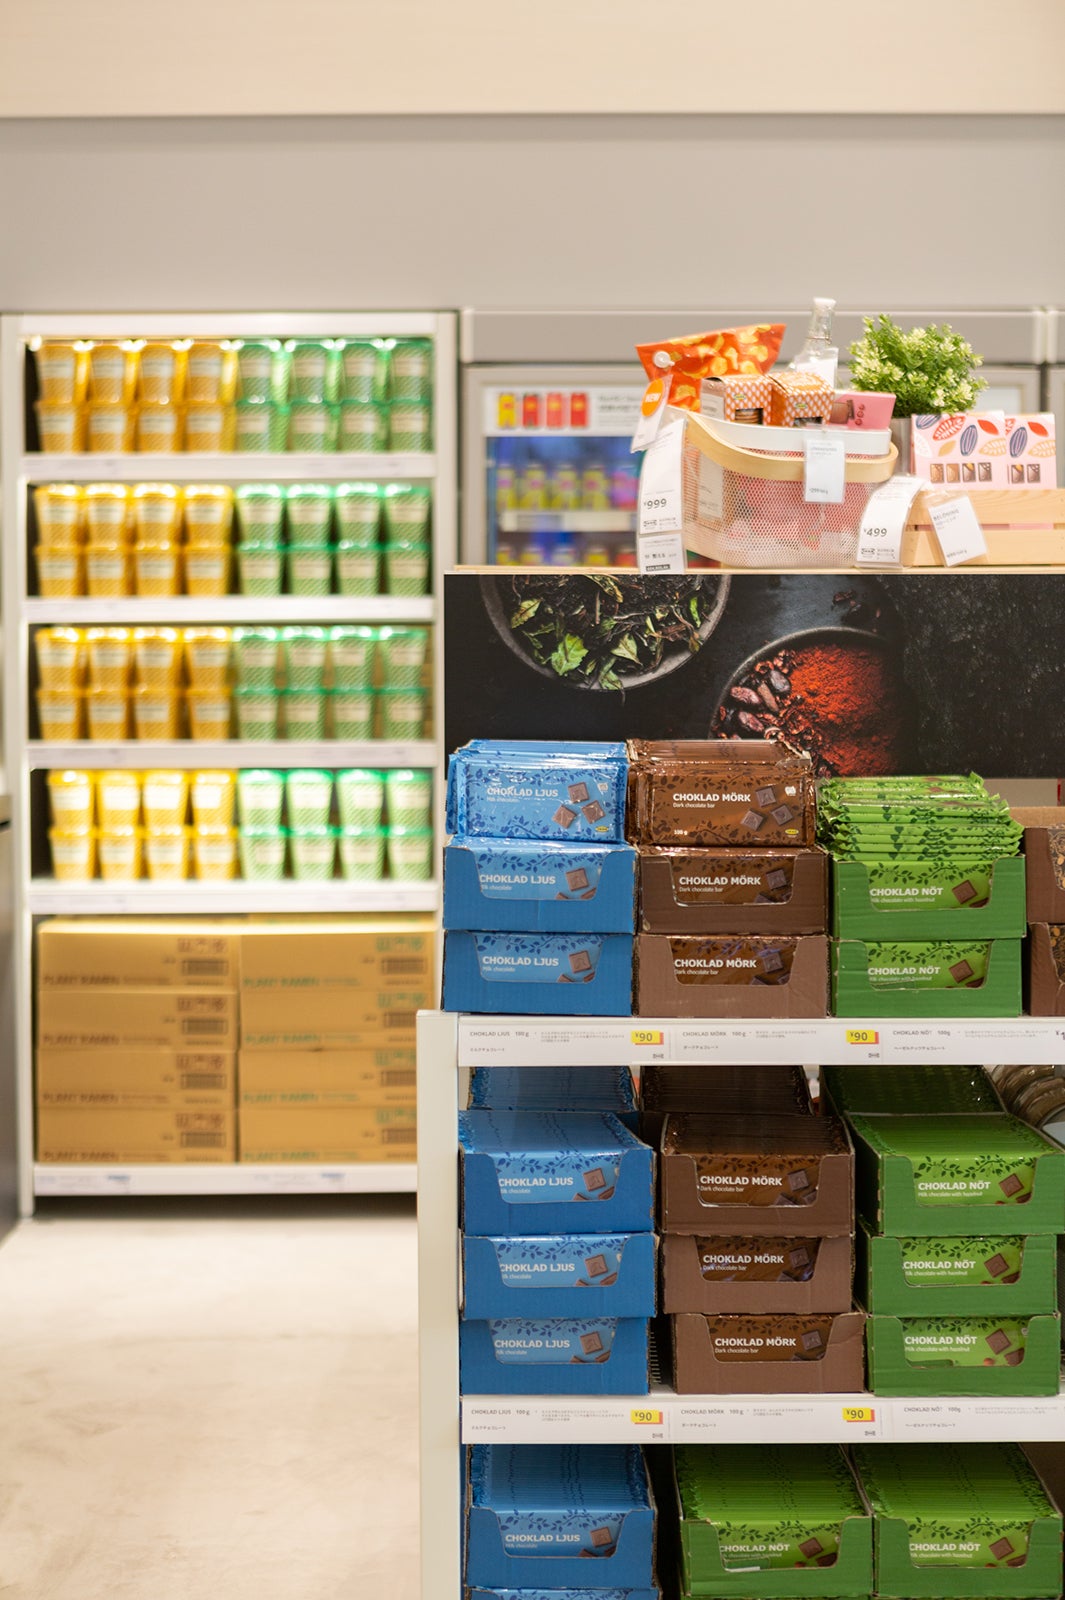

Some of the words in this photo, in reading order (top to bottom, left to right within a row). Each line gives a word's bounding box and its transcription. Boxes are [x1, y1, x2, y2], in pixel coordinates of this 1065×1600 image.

[864, 528, 888, 538] ¥499
[486, 787, 532, 797] CHOKLAD
[535, 789, 558, 797] LJUS
[722, 792, 751, 802] MÖRK
[480, 874, 528, 884] CHOKLAD
[531, 876, 556, 884] LJUS
[679, 877, 728, 885] CHOKLAD
[731, 875, 761, 885] MÖRK
[869, 888, 919, 896] CHOKLAD
[922, 886, 943, 896] NÖT
[482, 956, 531, 965] CHOKLAD
[534, 958, 559, 966] LJUS
[674, 959, 723, 968] CHOKLAD
[726, 958, 757, 968] MÖRK
[919, 966, 941, 975] NÖT
[635, 1032, 652, 1042] ¥90
[850, 1032, 868, 1041] ¥90
[499, 1178, 546, 1187] CHOKLAD
[549, 1177, 574, 1186] LJUS
[700, 1176, 749, 1185] CHOKLAD
[752, 1175, 782, 1186] MÖRK
[918, 1182, 967, 1190] CHOKLAD
[970, 1180, 991, 1189] NÖT
[703, 1255, 752, 1263] CHOKLAD
[754, 1254, 784, 1263] MÖRK
[500, 1264, 547, 1272] CHOKLAD
[550, 1263, 575, 1271] LJUS
[903, 1261, 952, 1269] CHOKLAD
[954, 1260, 976, 1269] NÖT
[494, 1340, 542, 1348] CHOKLAD
[545, 1340, 570, 1348] LJUS
[715, 1338, 764, 1346] CHOKLAD
[766, 1336, 796, 1346] MÖRK
[905, 1336, 953, 1345] CHOKLAD
[956, 1335, 977, 1344] NÖT
[635, 1412, 652, 1421] ¥90
[846, 1410, 864, 1419] ¥90
[769, 1543, 790, 1551] NÖT
[959, 1542, 980, 1551] NÖT
